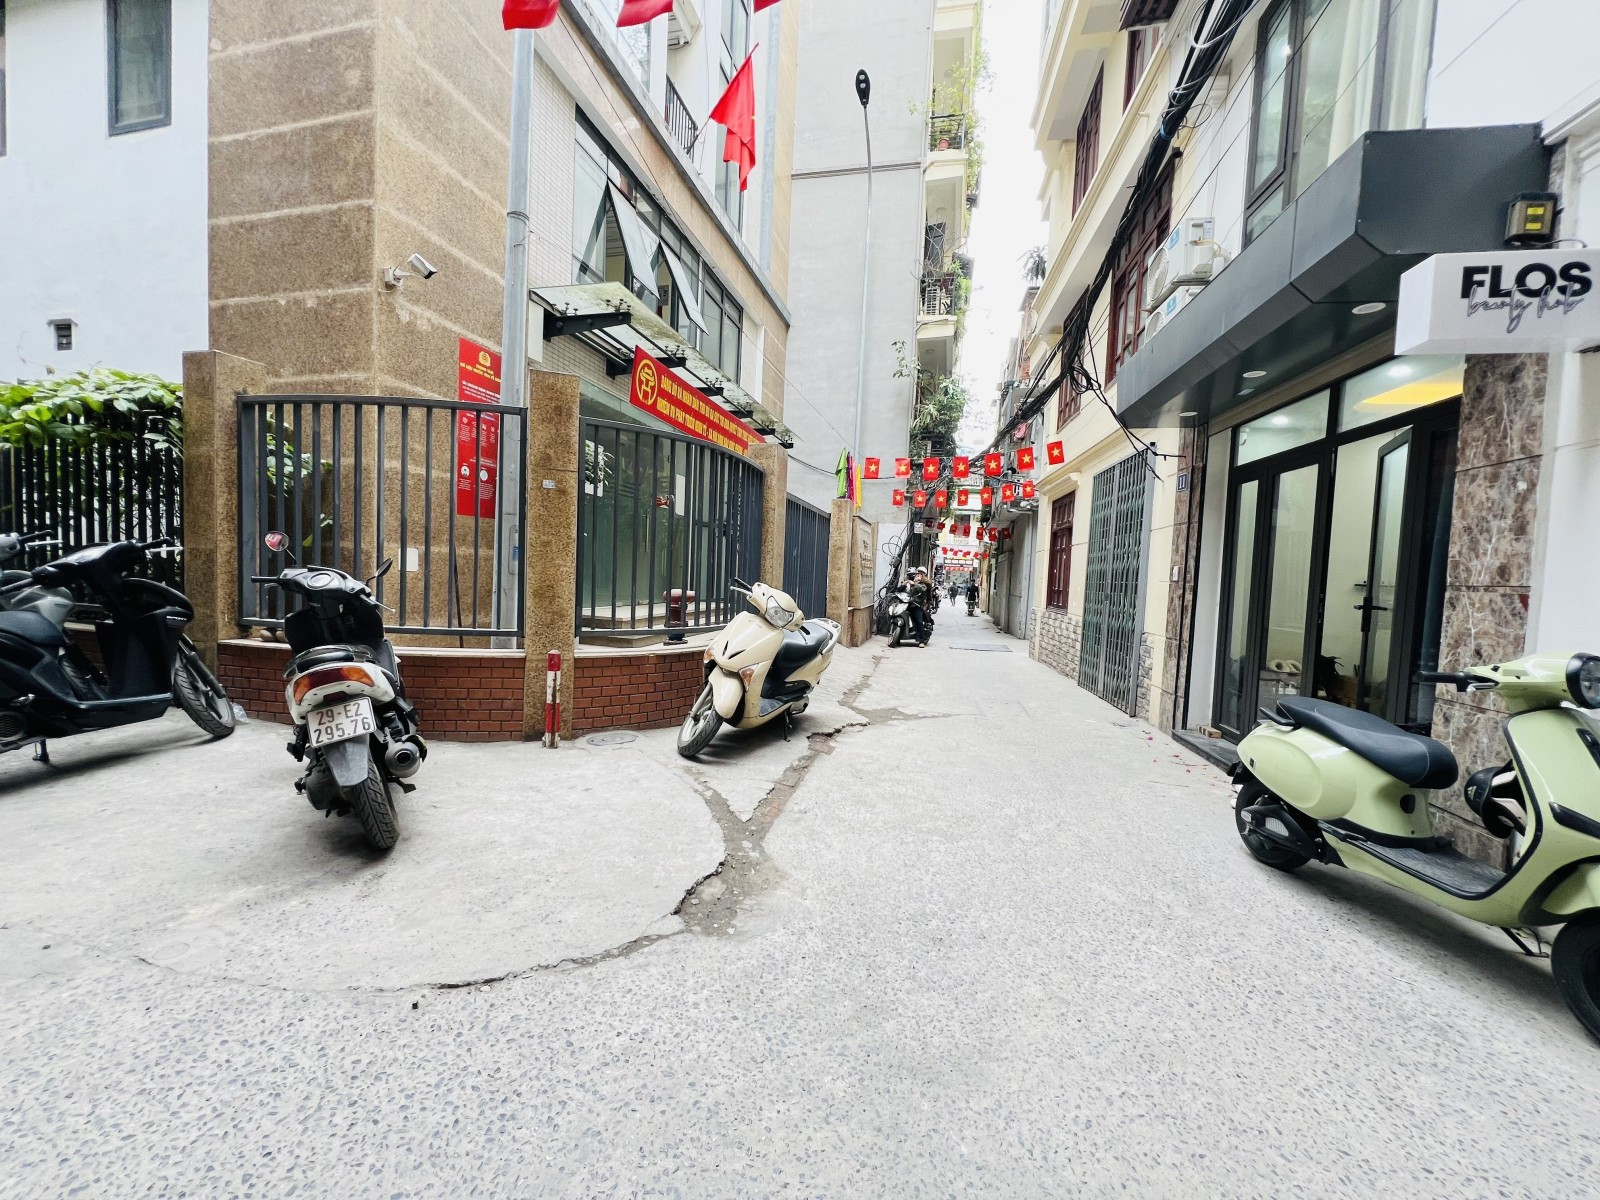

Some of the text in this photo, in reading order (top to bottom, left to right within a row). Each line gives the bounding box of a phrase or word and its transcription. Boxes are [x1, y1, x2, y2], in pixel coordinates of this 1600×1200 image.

[1460, 261, 1593, 299] FLOS
[315, 702, 363, 726] 29-E2
[313, 717, 371, 744] 295.76
